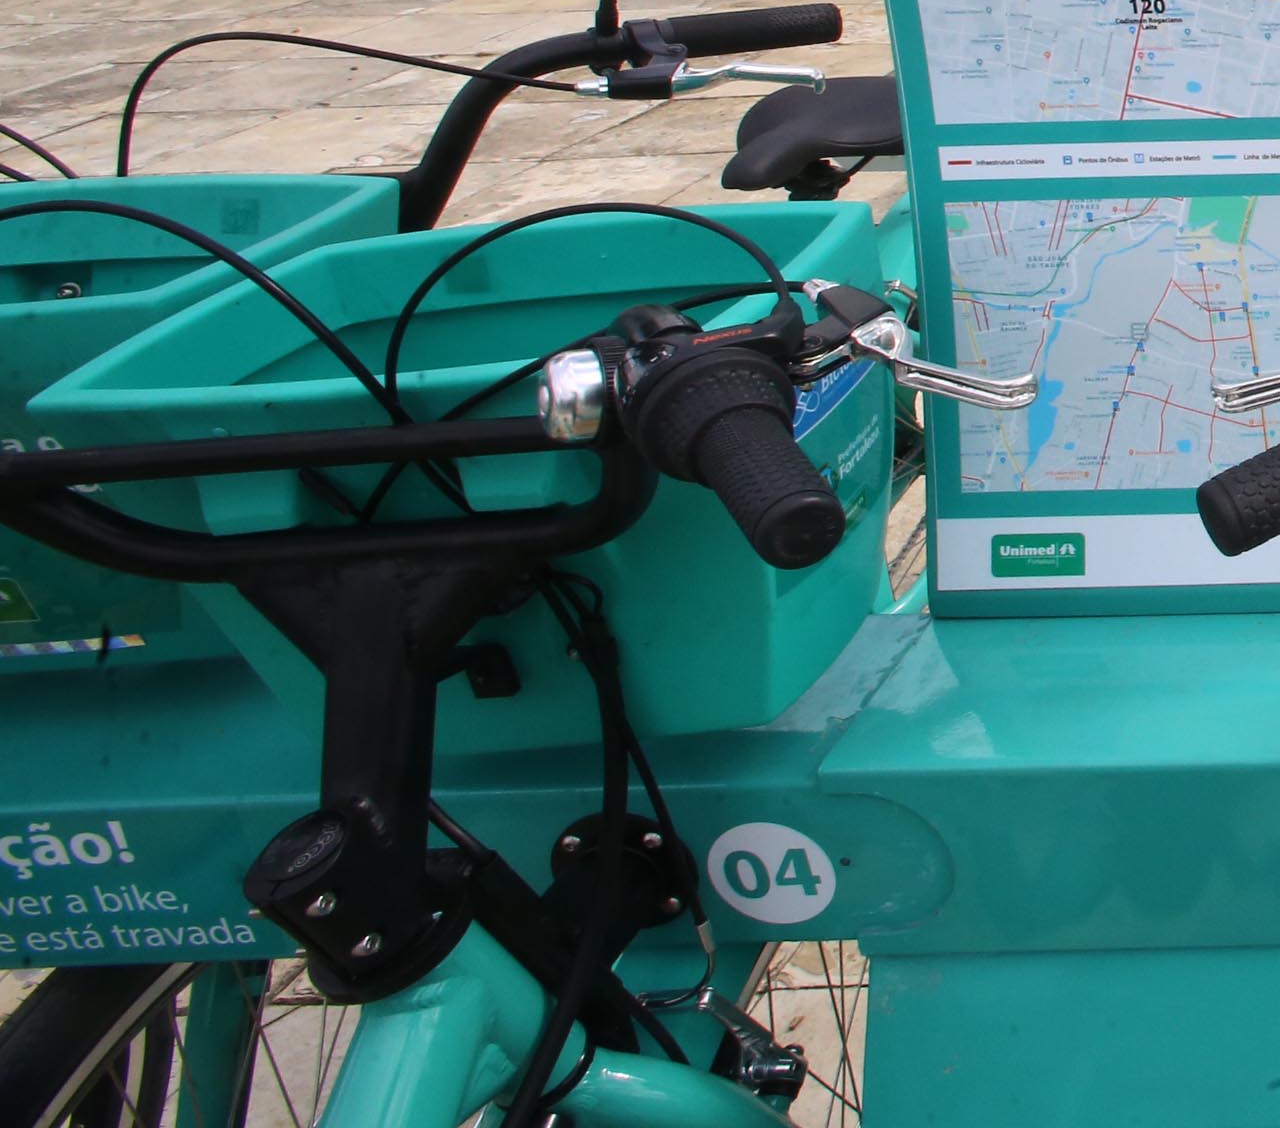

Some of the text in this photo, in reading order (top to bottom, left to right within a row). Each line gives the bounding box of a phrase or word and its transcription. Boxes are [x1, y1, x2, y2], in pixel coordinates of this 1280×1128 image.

[999, 542, 1056, 557] Unimed
[723, 847, 823, 900] 04
[65, 893, 88, 913] a
[93, 884, 189, 914] bike,
[26, 923, 104, 951] está
[111, 917, 256, 948] travada
